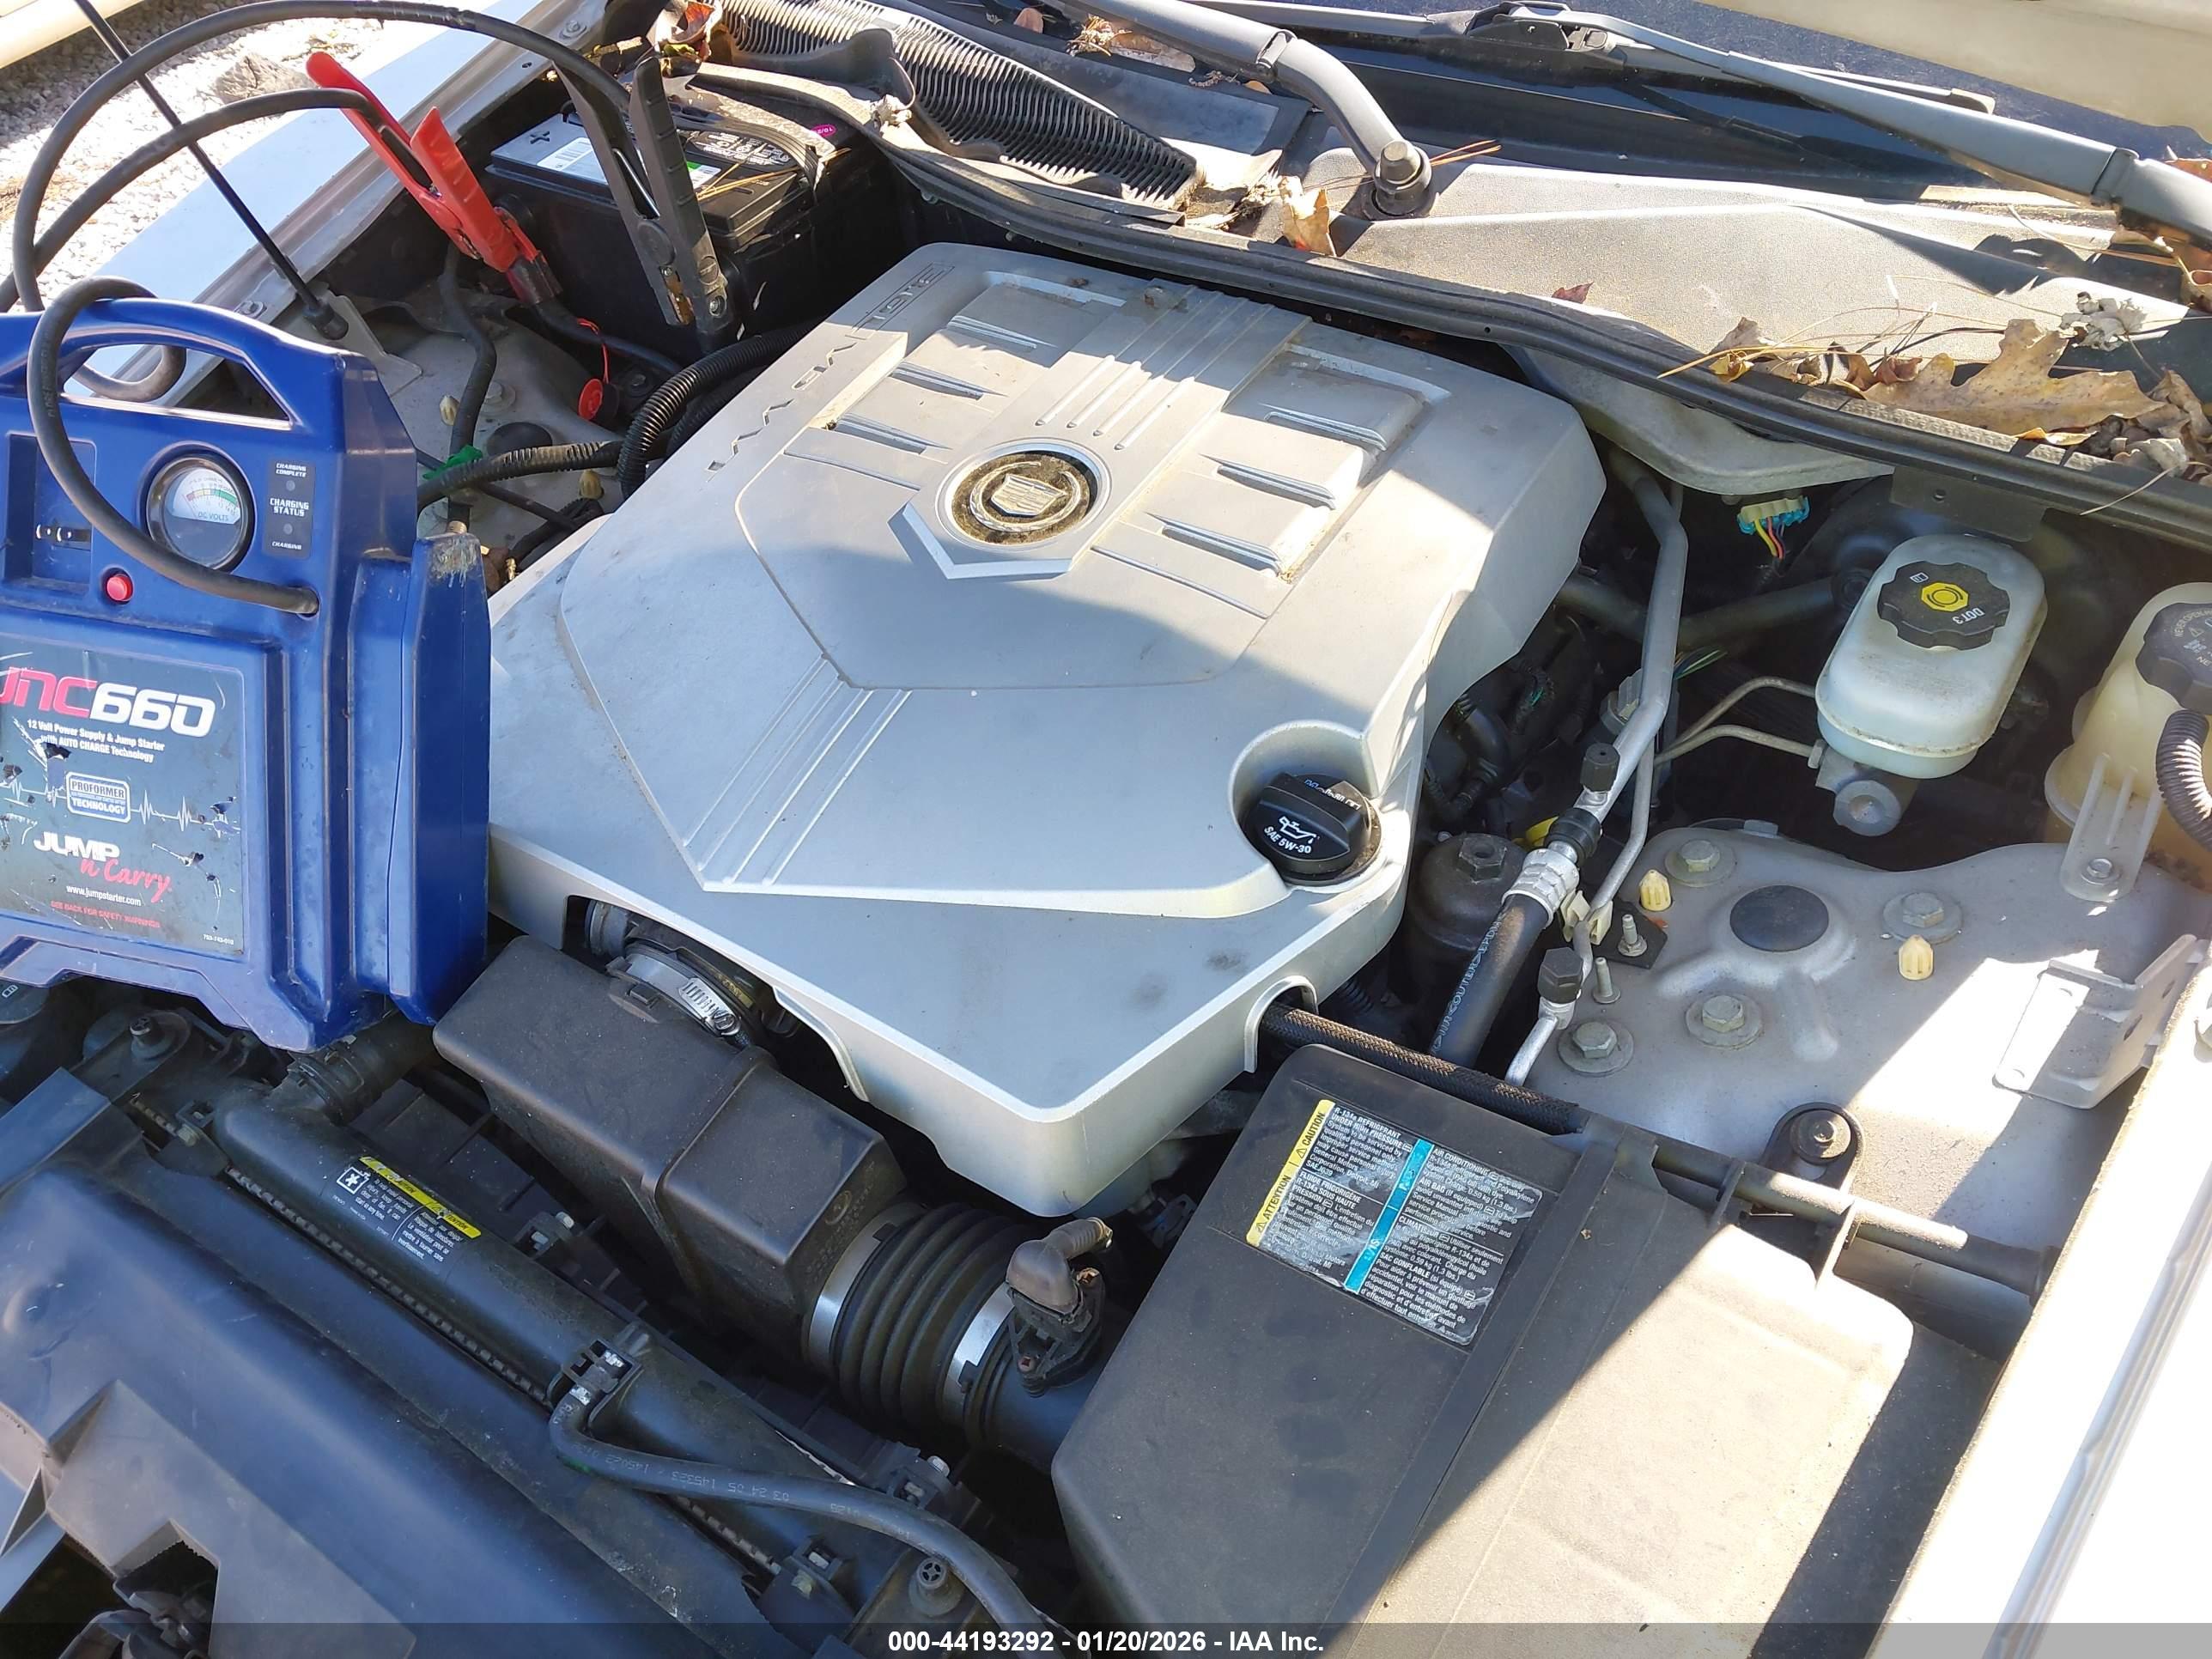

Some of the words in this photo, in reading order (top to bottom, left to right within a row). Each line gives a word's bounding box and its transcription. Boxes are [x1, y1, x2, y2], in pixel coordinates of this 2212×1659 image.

[276, 469, 306, 477] COMPLETE
[269, 497, 309, 510] CHARGING
[273, 506, 305, 516] STATUS
[271, 541, 301, 550] CHARGING
[1952, 614, 1964, 625] 3
[1963, 607, 1985, 622] DOT
[27, 719, 37, 728] 12
[53, 724, 78, 737] Power
[78, 728, 106, 743] Supply
[106, 733, 113, 742] &
[113, 734, 137, 748] Jump
[137, 738, 165, 751] Starter
[58, 737, 78, 748] AUTO
[79, 740, 110, 754] CHARGE
[110, 746, 154, 763] Technology
[70, 780, 125, 799] PROFORMER
[70, 797, 126, 815] TECHNOLOGY
[32, 830, 121, 865] JUMP
[1263, 826, 1279, 842] SAE
[1278, 837, 1311, 854] 5W-30
[65, 885, 142, 907] www.jumpstarter.com
[100, 860, 173, 905] Carry
[1301, 1111, 1325, 1146] CAUTION
[1322, 1127, 1350, 1143] qualified
[1349, 1139, 1382, 1157] personnel
[1326, 1120, 1351, 1134] System
[1366, 1137, 1394, 1152] serviced
[1393, 1148, 1402, 1158] by
[1312, 1146, 1337, 1161] General
[1336, 1158, 1358, 1170] Motors
[1316, 1140, 1329, 1151] may
[1329, 1146, 1350, 1158] cause
[1348, 1154, 1376, 1170] personal
[1319, 1133, 1348, 1150] Improper
[1347, 1146, 1371, 1159] service
[1308, 1153, 1346, 1174] Corporation,
[1432, 1148, 1444, 1158] AIR
[1443, 1152, 1489, 1176] CONDITIONING
[1261, 1175, 1291, 1220] ATTENTION
[1295, 1177, 1318, 1192] R-134a
[1317, 1188, 1335, 1200] SOUS
[1334, 1195, 1356, 1209] HAUTE
[1298, 1170, 1322, 1184] FLUIDE
[1320, 1179, 1363, 1203] FRIGORIGÈNE
[1414, 1184, 1432, 1196] avoid
[1431, 1192, 1463, 1209] unwanted
[1418, 1176, 1431, 1187] AIR
[1431, 1182, 1445, 1193] BAG
[1452, 1192, 1484, 1210] equipped)
[1491, 1189, 1505, 1200] dye.
[355, 1196, 365, 1206] start
[367, 1206, 376, 1214] any
[1291, 1184, 1322, 1202] PRESSION
[1334, 1204, 1366, 1223] L'entretien
[1365, 1218, 1375, 1226] du
[1411, 1191, 1435, 1206] Service
[1434, 1201, 1459, 1216] Manual
[1498, 1228, 1511, 1238] and
[1480, 1194, 1492, 1203] kg
[1490, 1197, 1504, 1208] (1.3
[391, 1211, 401, 1221] can
[1304, 1207, 1334, 1225] personnel
[1313, 1203, 1325, 1212] doit
[1337, 1214, 1364, 1230] effectué
[1404, 1206, 1438, 1225] performing
[1407, 1199, 1431, 1213] service
[1465, 1224, 1486, 1237] before
[401, 1229, 416, 1242] mettre
[418, 1242, 434, 1255] tourner
[433, 1252, 444, 1262] sans
[413, 1227, 434, 1243] ventilateur
[432, 1240, 443, 1251] peut
[1449, 1237, 1471, 1250] Utiliser
[1470, 1245, 1504, 1265] seulement
[1378, 1251, 1393, 1261] SAC
[1392, 1256, 1430, 1279] GONFLABLE
[1429, 1273, 1439, 1283] (si
[1401, 1243, 1416, 1254] avec
[1415, 1249, 1443, 1266] colorant.
[1443, 1261, 1468, 1277] Charge
[1467, 1271, 1476, 1279] du
[1450, 1246, 1474, 1261] R-134a
[1480, 1259, 1490, 1267] de
[1468, 1262, 1487, 1276] (huile
[1375, 1259, 1389, 1270] Pour
[1389, 1266, 1406, 1277] aider
[1411, 1275, 1438, 1293] prévenir
[1437, 1287, 1448, 1297] un
[1446, 1291, 1476, 1311] gonflage
[1423, 1261, 1432, 1270] kg
[1444, 1271, 1460, 1282] lbs.)
[1359, 1288, 1395, 1309] d'effectuer
[1394, 1304, 1407, 1316] tout
[1367, 1273, 1399, 1292] réparation
[1398, 1289, 1414, 1300] pour
[1413, 1295, 1425, 1304] les
[1424, 1300, 1457, 1320] méthodes
[1456, 1315, 1467, 1323] de
[1370, 1266, 1405, 1286] accidentel,
[1404, 1281, 1417, 1291] voir
[1424, 1291, 1449, 1307] manuel
[1448, 1302, 1458, 1311] de
[1363, 1281, 1395, 1301] diagnostic
[1437, 1316, 1456, 1328] avant
